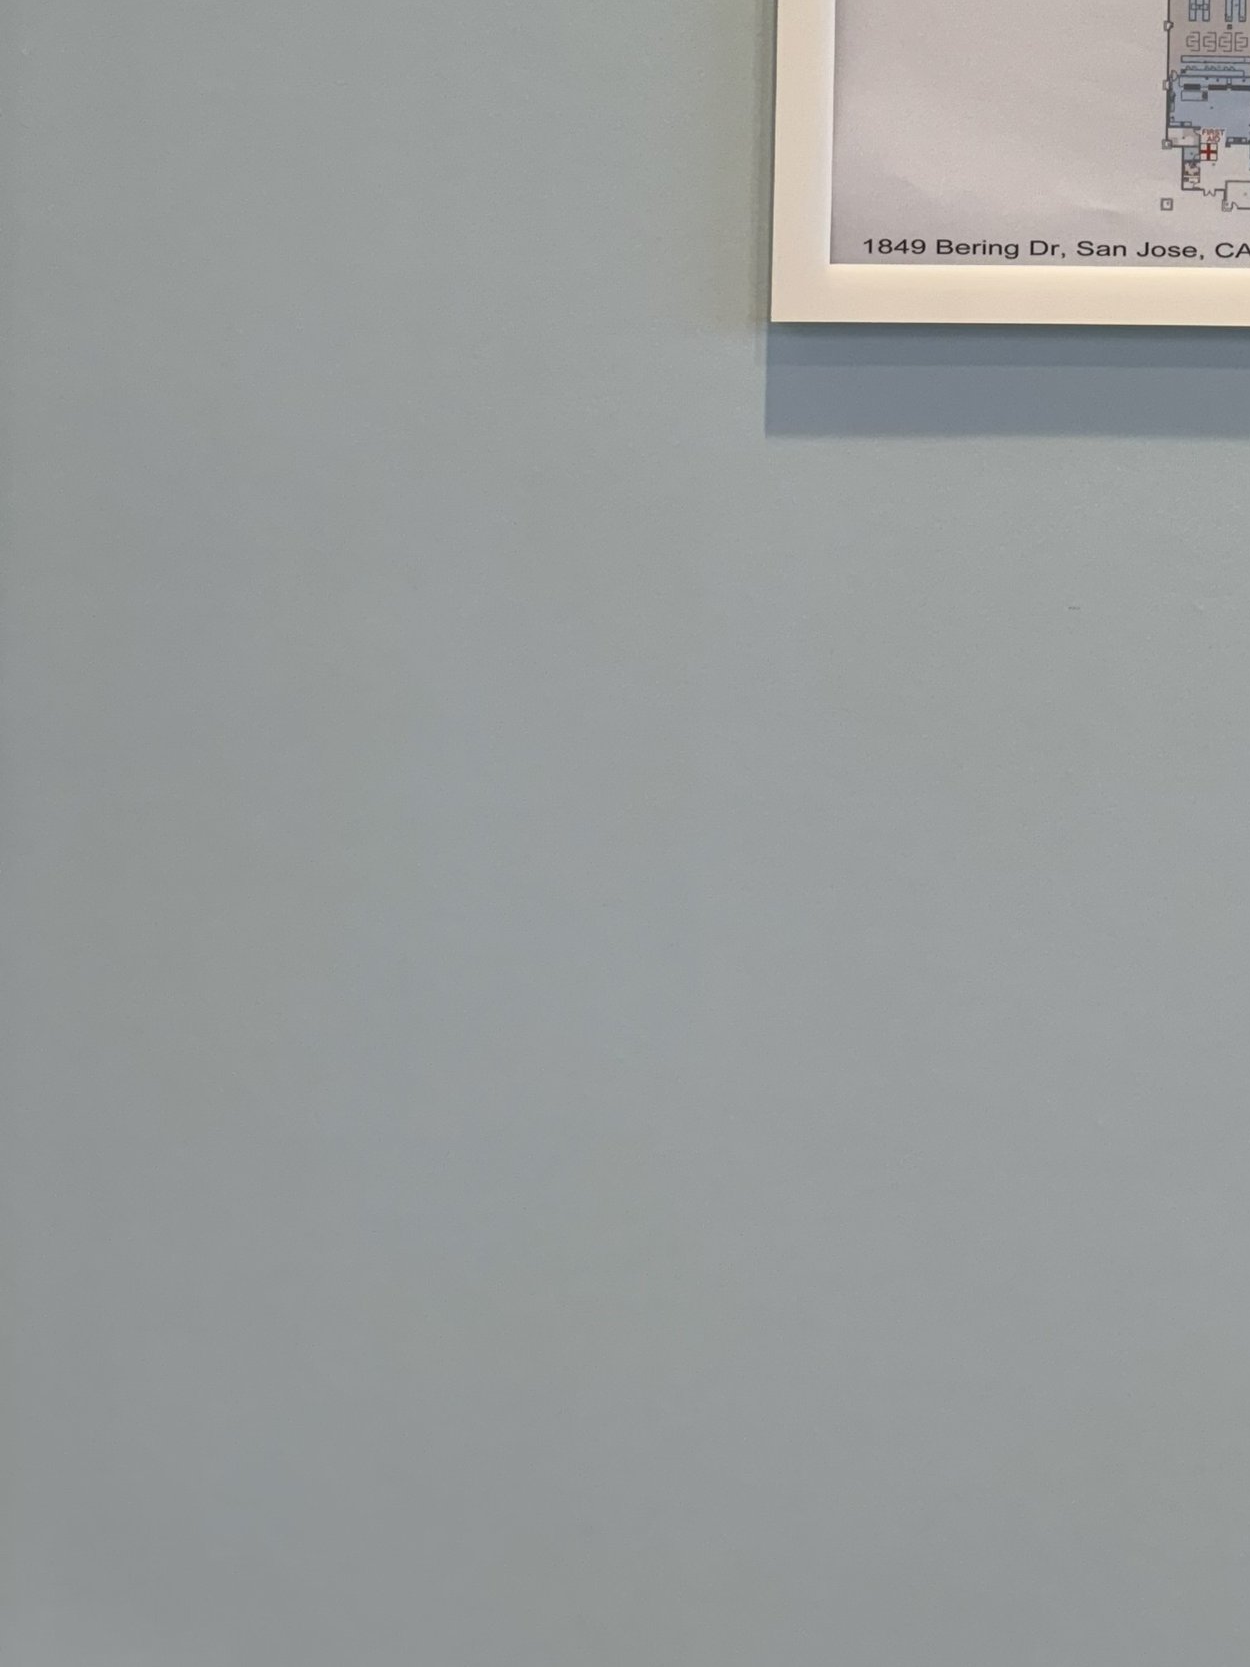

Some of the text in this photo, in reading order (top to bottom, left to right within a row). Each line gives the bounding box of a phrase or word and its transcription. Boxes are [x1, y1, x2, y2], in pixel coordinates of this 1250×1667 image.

[1201, 128, 1225, 136] FIRST
[1206, 135, 1221, 143] AID
[863, 238, 927, 255] 1849
[935, 239, 1020, 260] Bering
[1029, 240, 1066, 259] Dr,
[1076, 240, 1127, 257] San
[1136, 241, 1205, 261] Jose,
